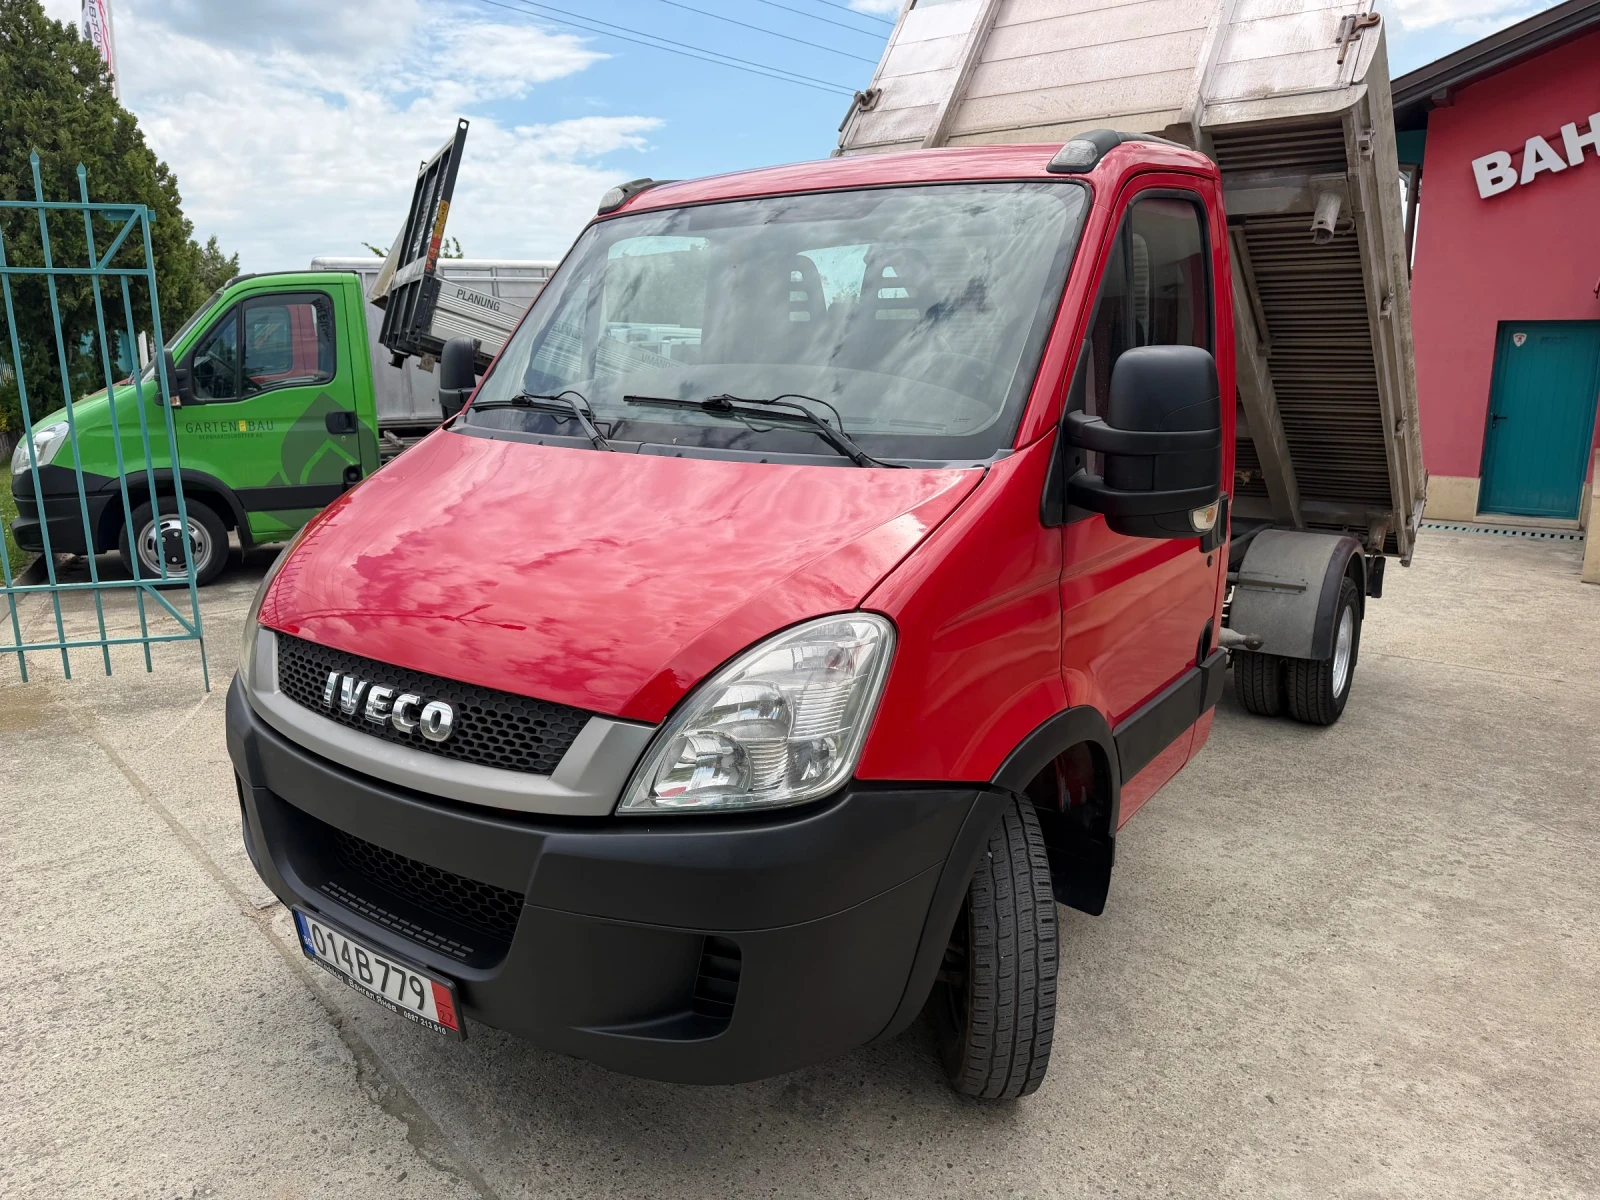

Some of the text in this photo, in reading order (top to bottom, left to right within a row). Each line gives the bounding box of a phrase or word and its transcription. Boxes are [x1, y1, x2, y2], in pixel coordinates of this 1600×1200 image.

[456, 288, 501, 311] PLANUNG
[185, 421, 237, 433] GARTEN
[248, 420, 274, 432] BAU
[323, 671, 456, 742] IVECO
[311, 923, 425, 1011] 014B779
[420, 1018, 433, 1029] 213
